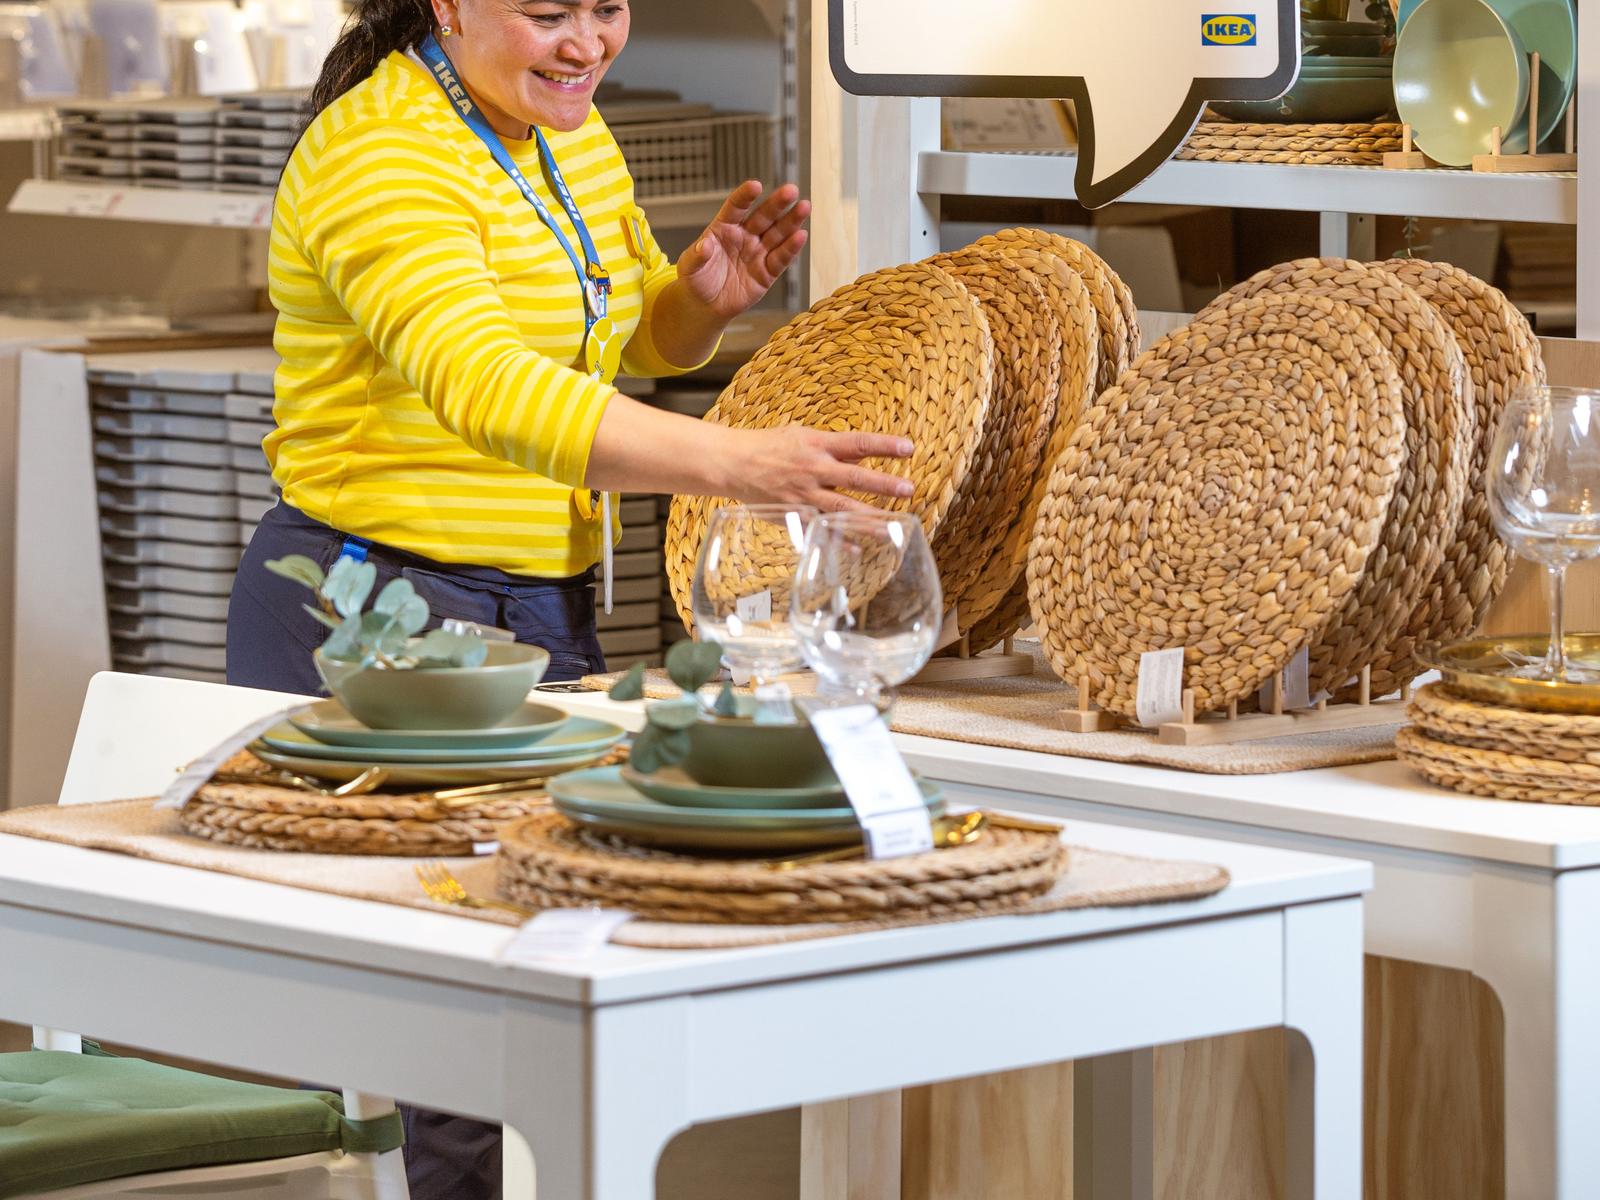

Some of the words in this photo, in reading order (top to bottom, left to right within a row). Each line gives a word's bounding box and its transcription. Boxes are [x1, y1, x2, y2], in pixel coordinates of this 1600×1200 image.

[1207, 23, 1252, 36] IKEA
[433, 61, 473, 116] IKEA
[510, 168, 549, 219] IKEA
[553, 170, 581, 221] IKEA
